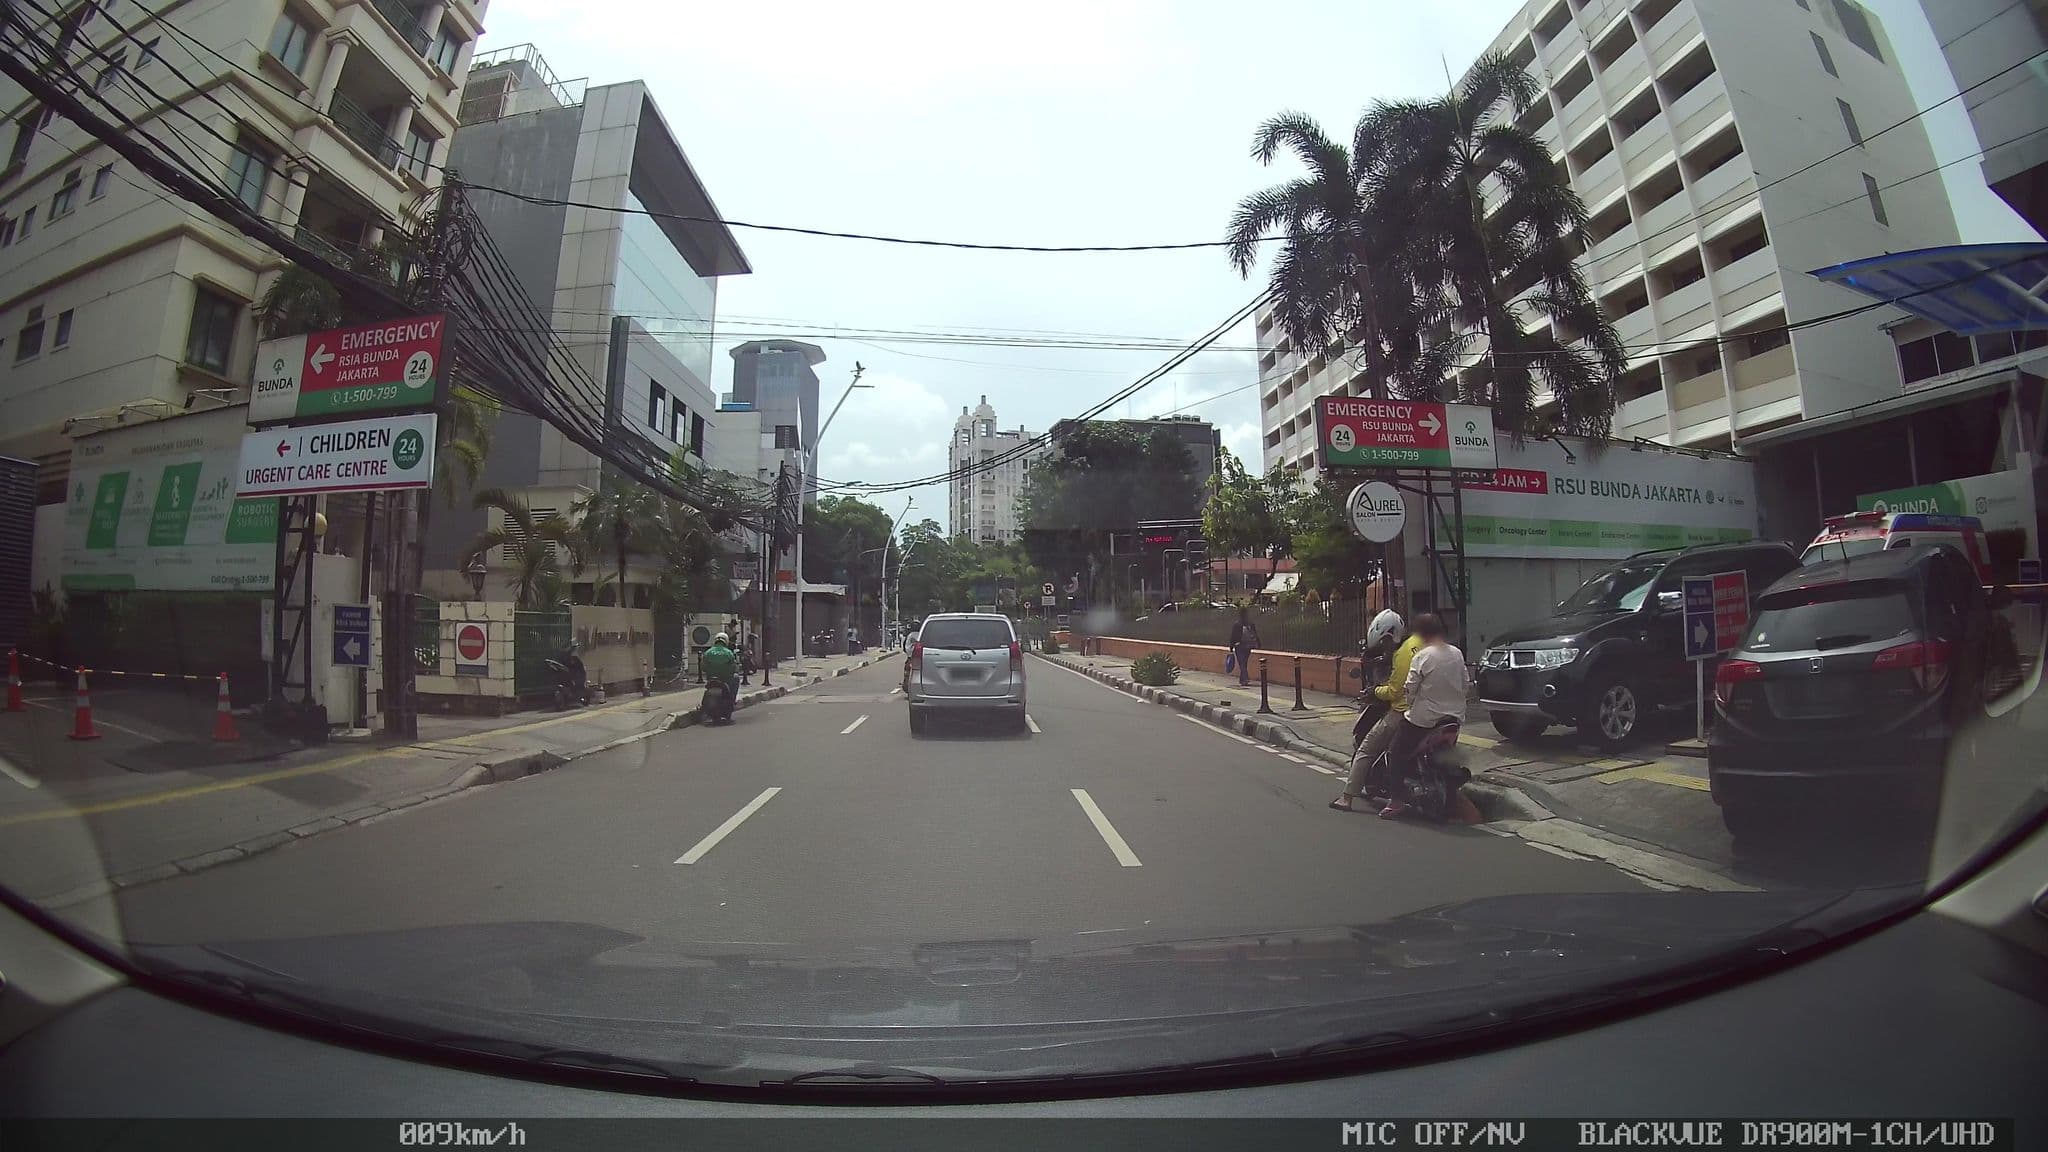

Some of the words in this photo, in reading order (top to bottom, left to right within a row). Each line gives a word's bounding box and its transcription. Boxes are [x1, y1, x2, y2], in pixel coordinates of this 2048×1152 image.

[341, 321, 441, 350] EMERGENCY
[339, 353, 360, 367] RSIA
[363, 349, 400, 364] BUNDA
[410, 359, 427, 374] 24
[336, 367, 380, 382] JAKARTA
[258, 377, 293, 392] BUNDA
[343, 386, 398, 404] 1-500-799
[1327, 403, 1413, 419] EMERGENCY
[1362, 421, 1380, 430] RSU
[1382, 422, 1414, 432] BUNDA
[310, 428, 391, 454] CHILDREN
[1335, 430, 1350, 442] 24
[1377, 433, 1416, 443] JAKARTA
[1455, 436, 1489, 447] BUNDA
[399, 437, 417, 454] 24
[398, 454, 416, 462] HOURS
[1372, 450, 1419, 461] 1-500-799
[245, 466, 294, 485] URGENT
[298, 463, 331, 481] CARE
[336, 459, 388, 478] CENTRE
[1501, 474, 1527, 488] JAM
[1555, 477, 1586, 495] RSU
[1591, 480, 1641, 500] BUNDA
[1644, 485, 1701, 504] JAKARTA
[1359, 491, 1402, 511] AUREL
[238, 503, 275, 516] ROBOTIC
[1499, 526, 1526, 536] Oncology
[1528, 528, 1548, 536] Center
